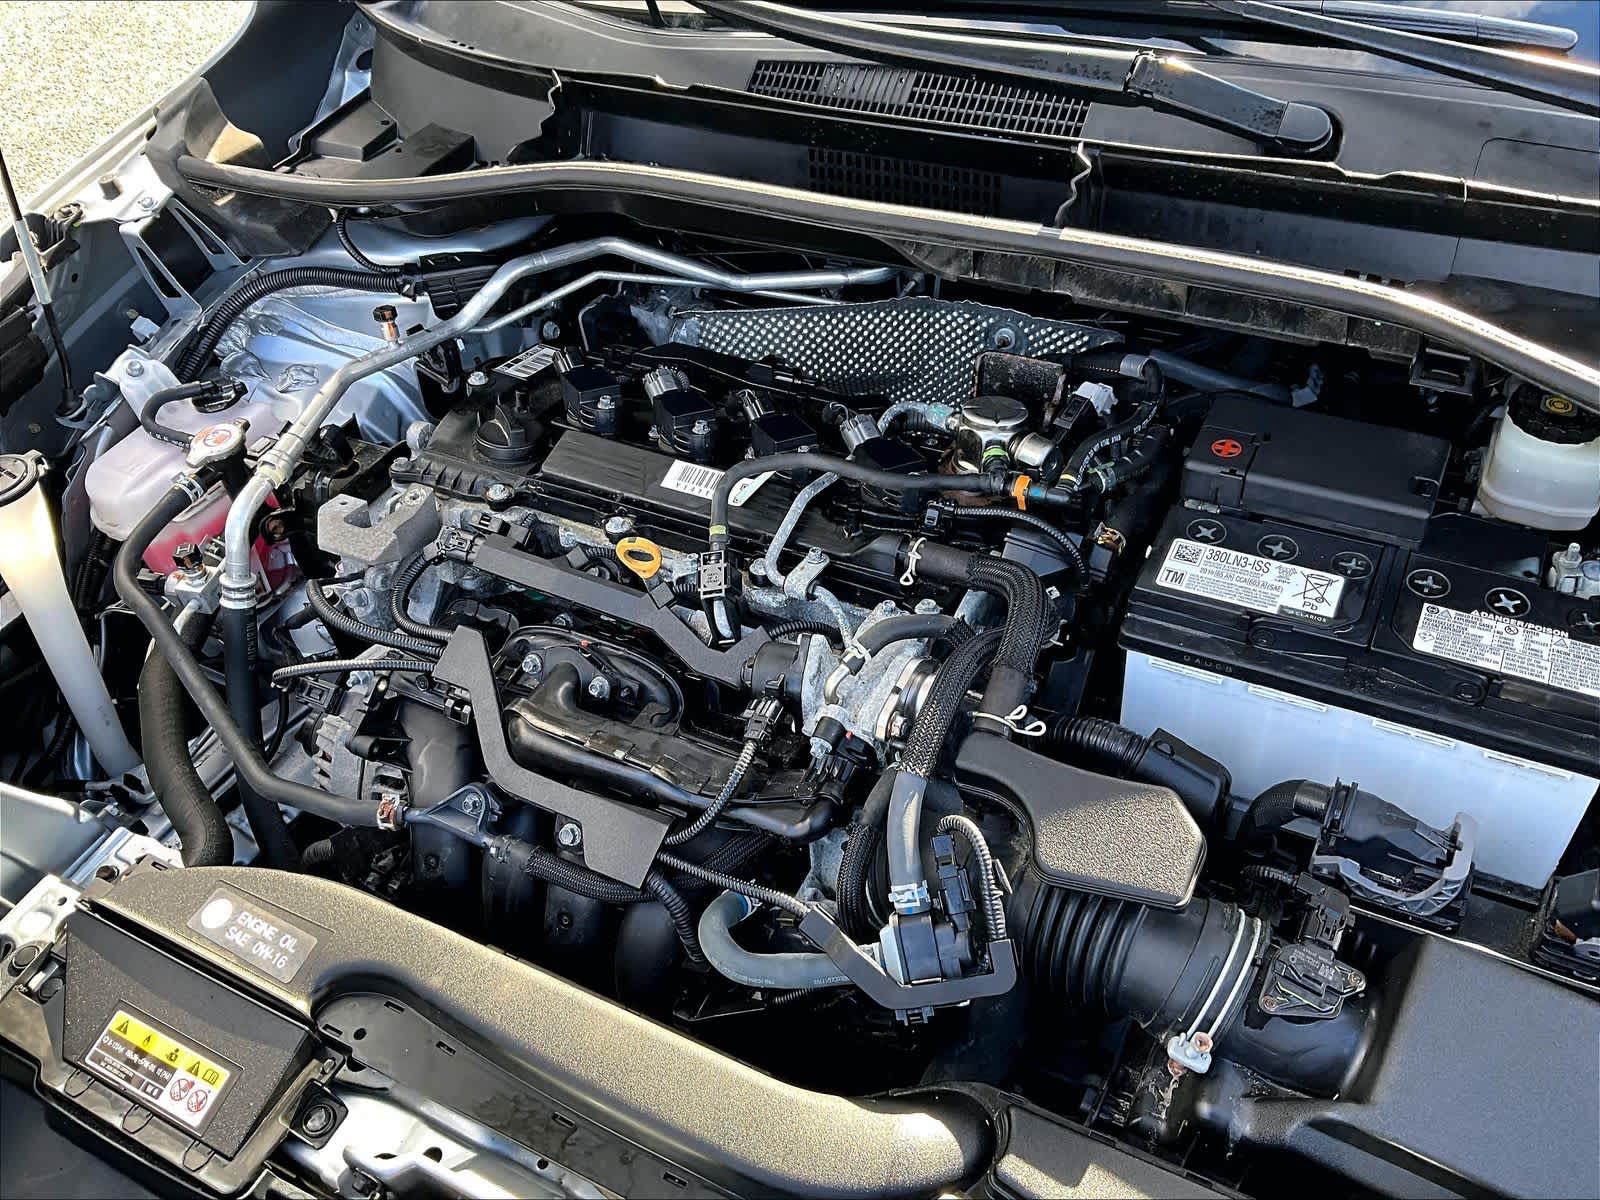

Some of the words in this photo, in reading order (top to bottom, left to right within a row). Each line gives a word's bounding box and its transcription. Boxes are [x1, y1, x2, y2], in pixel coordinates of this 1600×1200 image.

[1206, 548, 1272, 574] 380LN3-ISS
[1164, 568, 1185, 585] TM
[1302, 601, 1318, 611] Pb
[1480, 611, 1569, 638] DANGER/POISON
[234, 911, 276, 941] ENGINE
[279, 935, 296, 953] OIL
[225, 925, 249, 948] SAE
[253, 941, 289, 969] 0W-16
